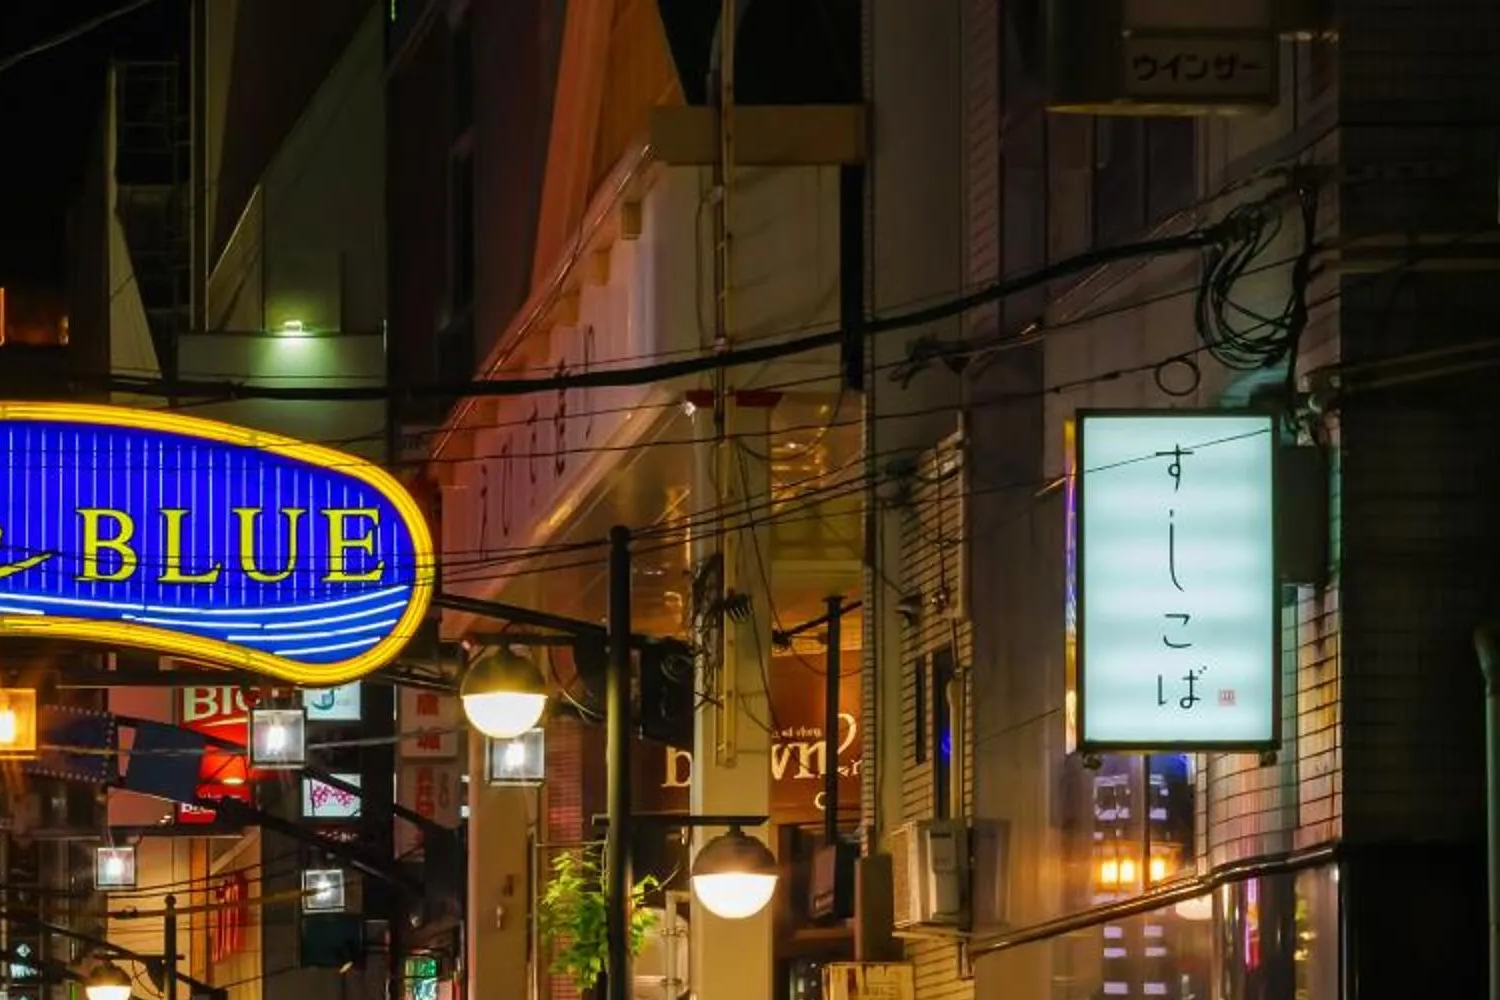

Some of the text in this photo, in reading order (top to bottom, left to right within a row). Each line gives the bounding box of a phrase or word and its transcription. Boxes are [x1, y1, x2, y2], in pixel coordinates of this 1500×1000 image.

[73, 507, 385, 583] BLUE
[1155, 443, 1208, 710] すしこば
